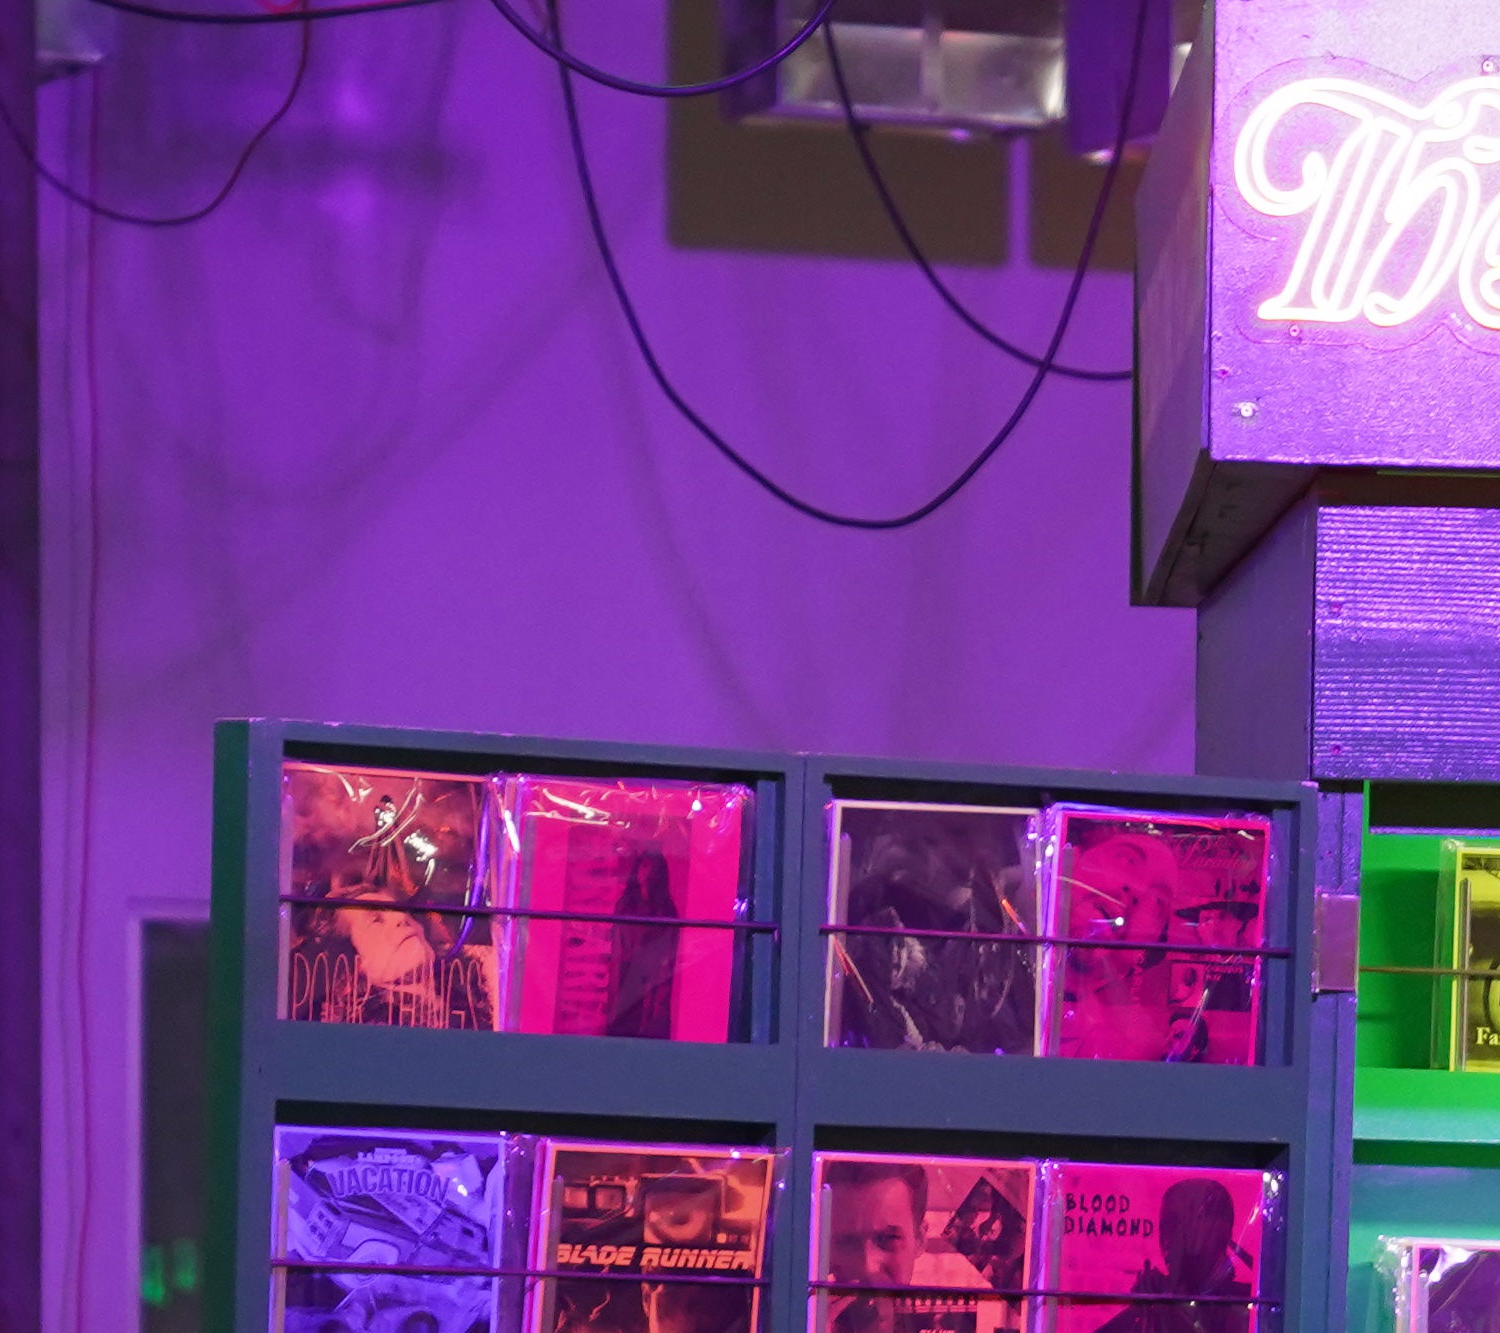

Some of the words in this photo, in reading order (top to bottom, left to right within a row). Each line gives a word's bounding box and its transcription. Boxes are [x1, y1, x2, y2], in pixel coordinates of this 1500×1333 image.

[326, 1162, 451, 1202] VACATION
[1065, 1192, 1131, 1214] BLOOD
[1064, 1218, 1155, 1239] DIAMOND
[556, 1243, 635, 1266] BLADE
[639, 1245, 755, 1271] RUNNER
